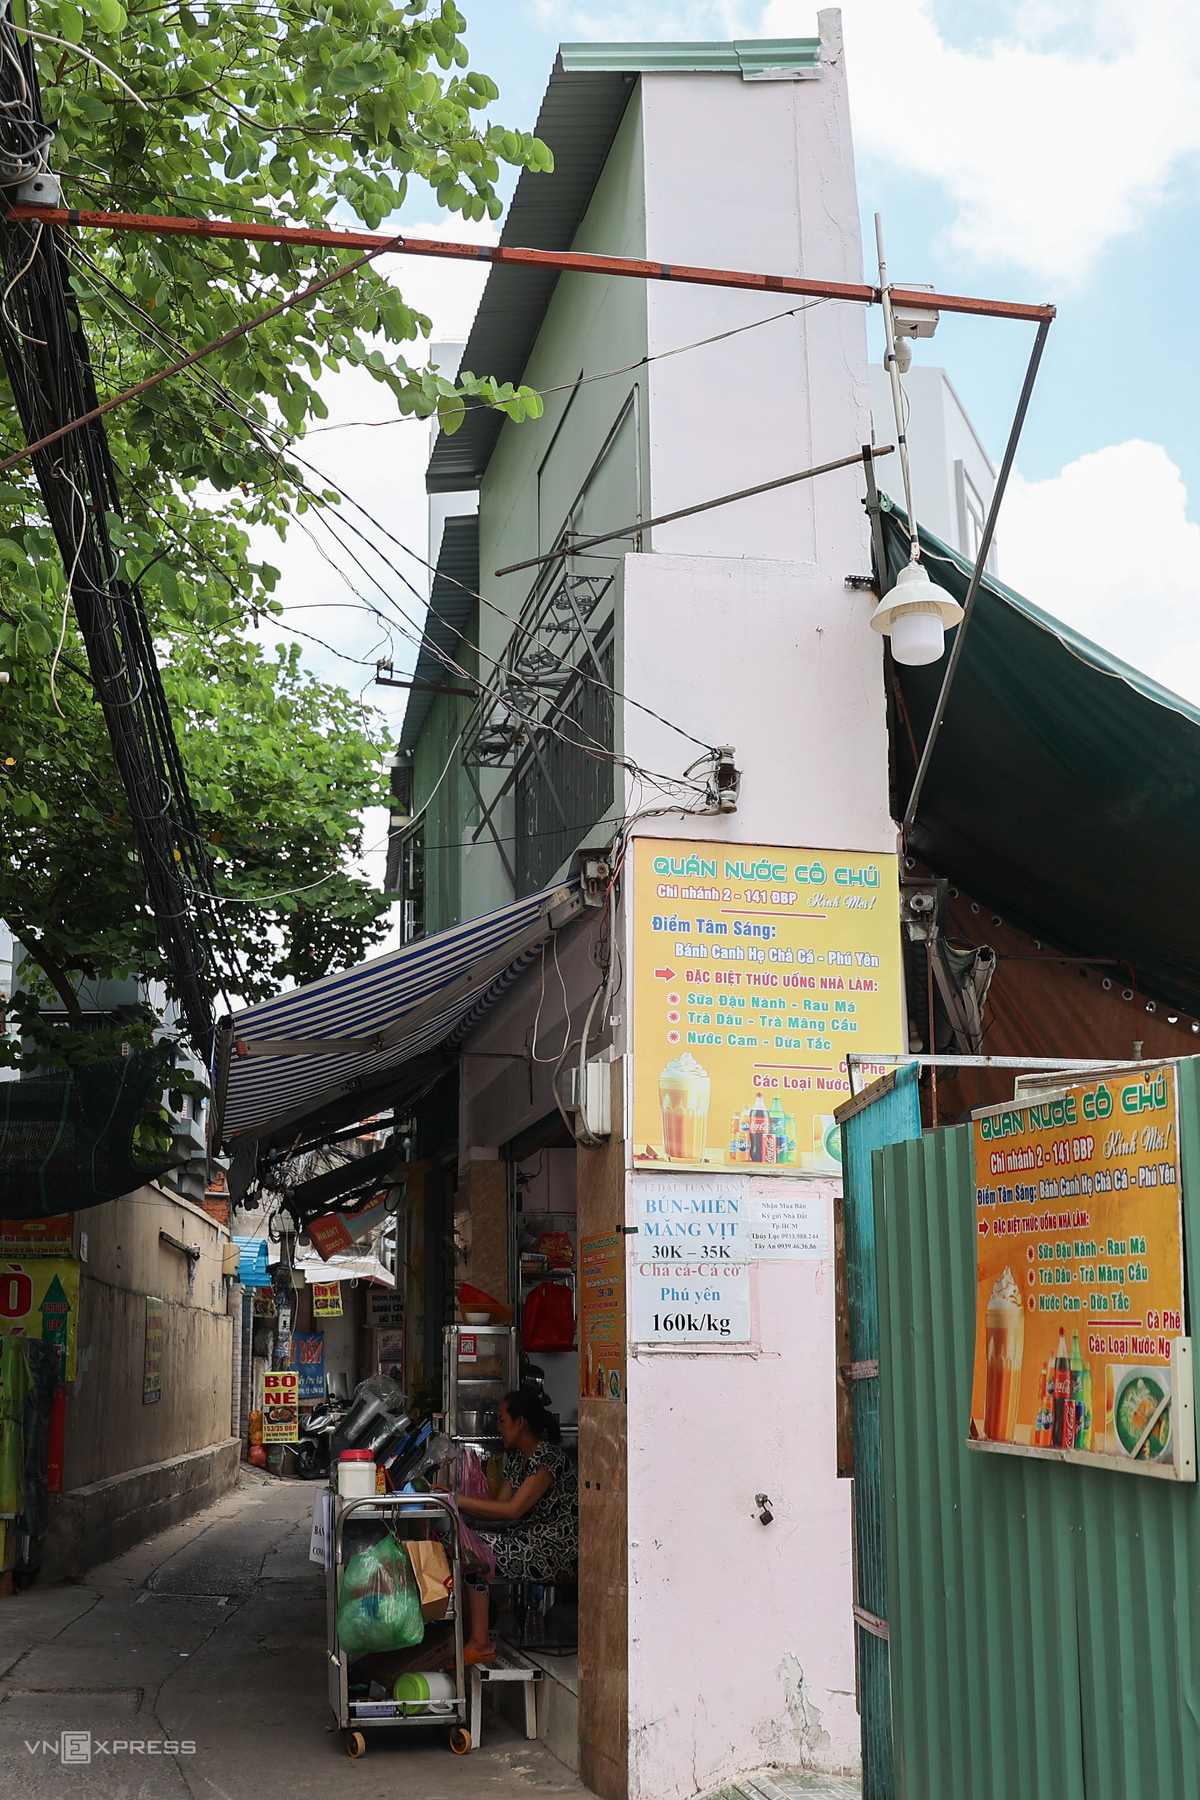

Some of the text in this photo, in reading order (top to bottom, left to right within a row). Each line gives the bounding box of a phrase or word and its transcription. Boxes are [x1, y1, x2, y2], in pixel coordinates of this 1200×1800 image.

[653, 855, 880, 887] QUÁN NƯỚC CÔ CHÚ
[657, 884, 798, 905] Chi nhánh 2 141 ĐBP
[652, 914, 777, 940] Điểm Tâm Sáng:
[675, 942, 880, 968] Bánh Canh Hẹ Chả Cá Phú Yên
[686, 968, 879, 992] ĐẶC BIỆT THỨC UỐNG NHÀ LÀM:
[688, 992, 856, 1013] Sữa Đậu Nành Rau Má
[688, 1011, 858, 1032] Trà Dâu Trà Mãng Cầu
[688, 1032, 832, 1050] Nước Cam Dừa Tắc
[753, 1074, 778, 1089] Các
[784, 1075, 812, 1092] Loại
[816, 1077, 850, 1092] Nước
[1082, 1083, 1113, 1121] CÔ
[1121, 1073, 1168, 1114] CHÚ
[990, 1136, 1095, 1174] Chi nhánh 2 141 ĐBP
[977, 1162, 1176, 1206] Điểm Tâm Sáng: Bánh Canh Hẹ Chả Cá Phú Yên
[644, 1218, 739, 1240] MĂNG VỊT
[771, 1222, 798, 1230] Tp.HCM
[1022, 1214, 1038, 1232] THỨC
[1038, 1208, 1057, 1230] UỐNG
[1058, 1209, 1072, 1228] NHÀ
[1072, 1208, 1090, 1228] LÀM:
[652, 1245, 731, 1259] 30K 35K
[1038, 1236, 1147, 1263] Sữa Đậu Nành Rau Má
[1038, 1264, 1149, 1286] Trà Dâu Trà Mãng Cầu
[660, 1287, 721, 1304] Phú yên
[1039, 1290, 1130, 1312] Nước Cam Dừa Tắc
[652, 1313, 731, 1336] 160k/kg
[1147, 1310, 1182, 1330] Cà Phê
[1088, 1335, 1172, 1360] Các Loại Nước Ng
[264, 1373, 296, 1388] BÒ
[264, 1390, 296, 1404] NÉ
